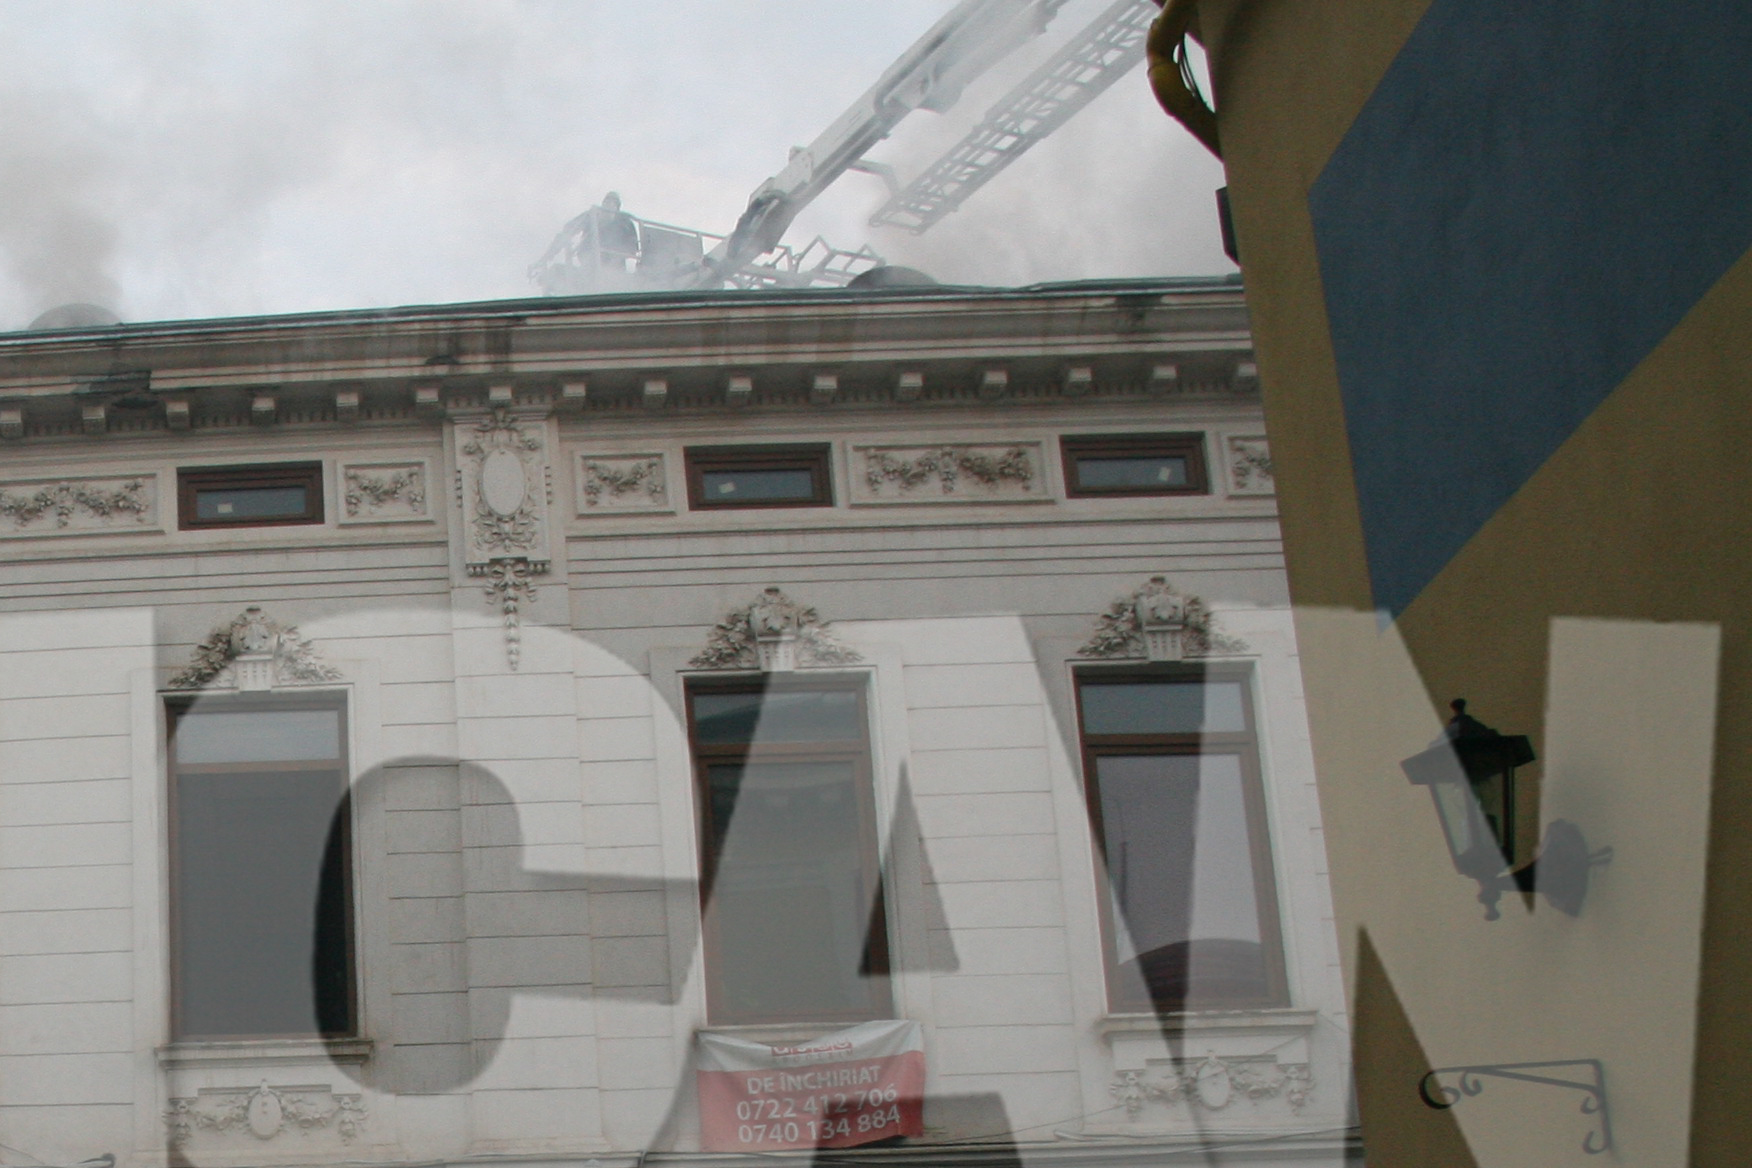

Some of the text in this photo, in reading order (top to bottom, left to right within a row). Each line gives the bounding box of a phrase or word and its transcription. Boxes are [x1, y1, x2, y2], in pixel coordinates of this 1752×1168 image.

[736, 1083, 898, 1121] 0722 412 706
[747, 1077, 775, 1095] DE
[738, 1104, 901, 1143] 0740 134 884
